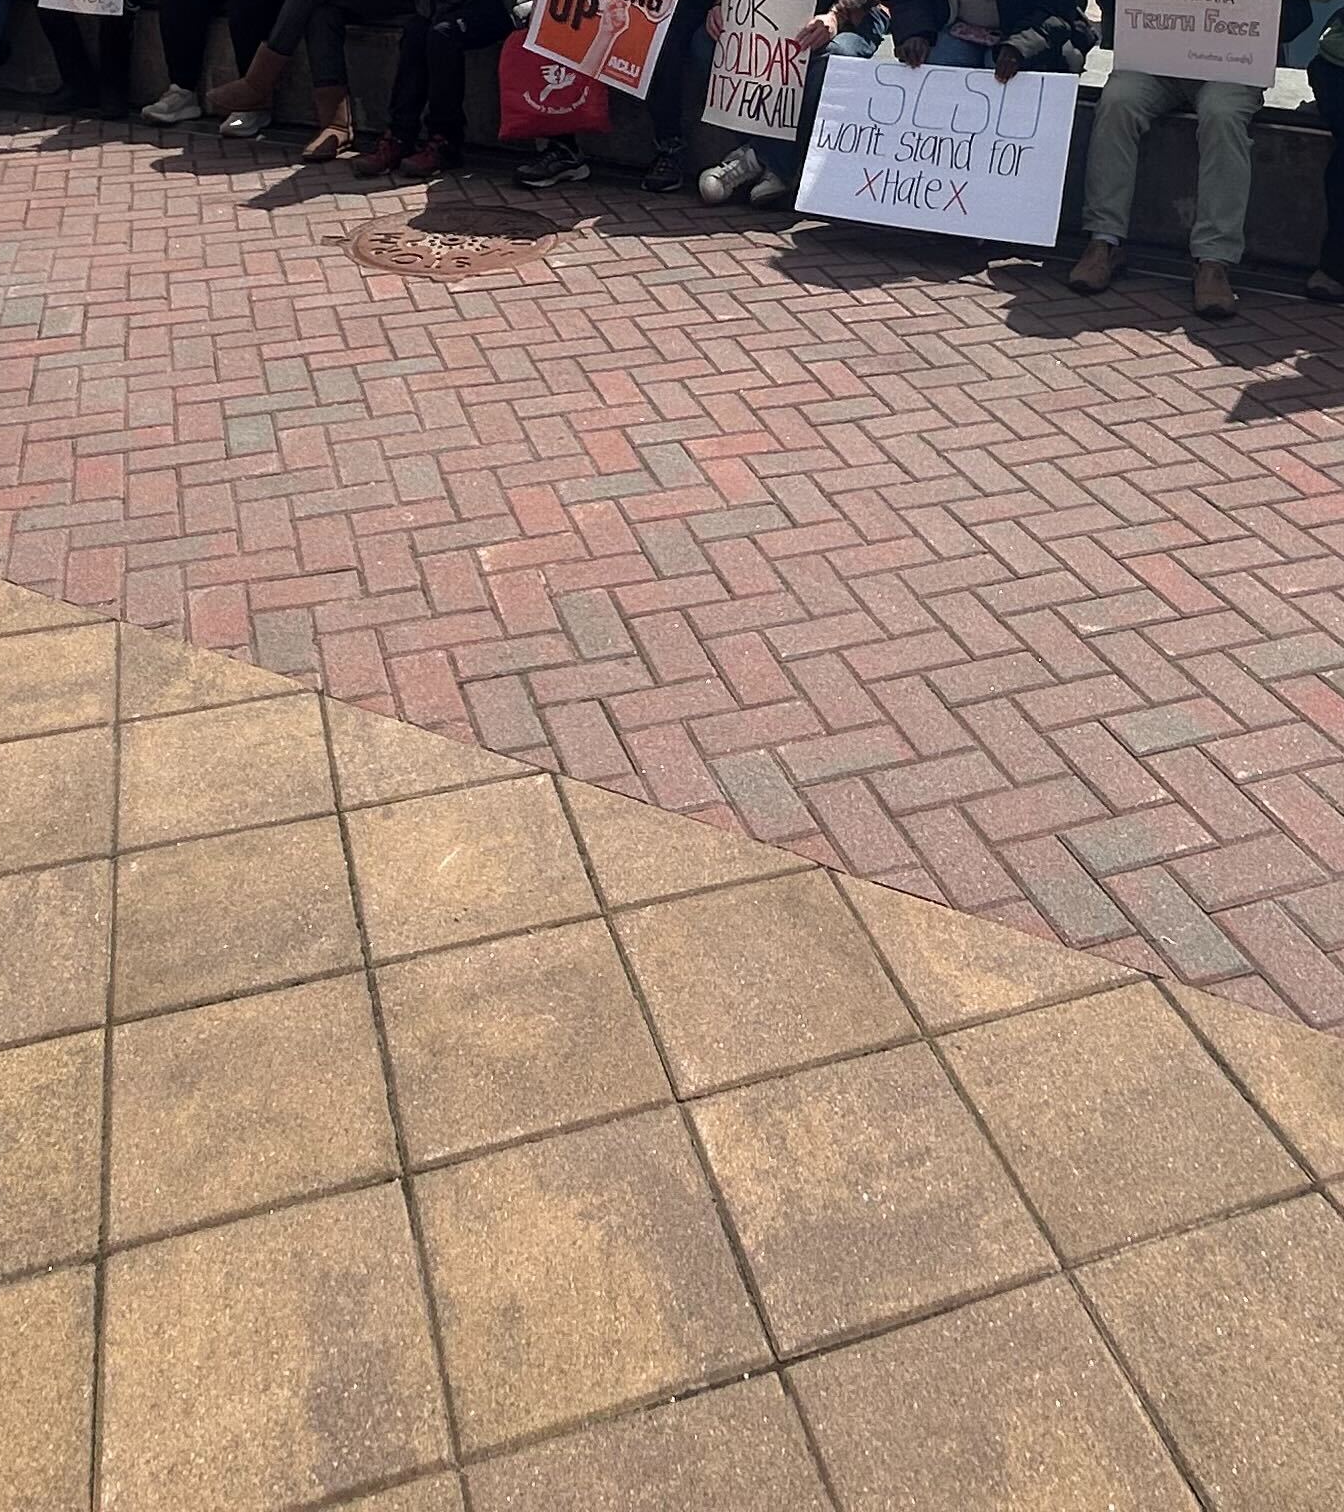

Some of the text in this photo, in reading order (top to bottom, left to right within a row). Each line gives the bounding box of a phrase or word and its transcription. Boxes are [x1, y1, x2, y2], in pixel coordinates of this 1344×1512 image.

[1124, 8, 1196, 32] TRUTH
[607, 56, 641, 78] ACLU
[709, 73, 799, 129] ITY FOR ALL
[867, 62, 1046, 139] SCSU
